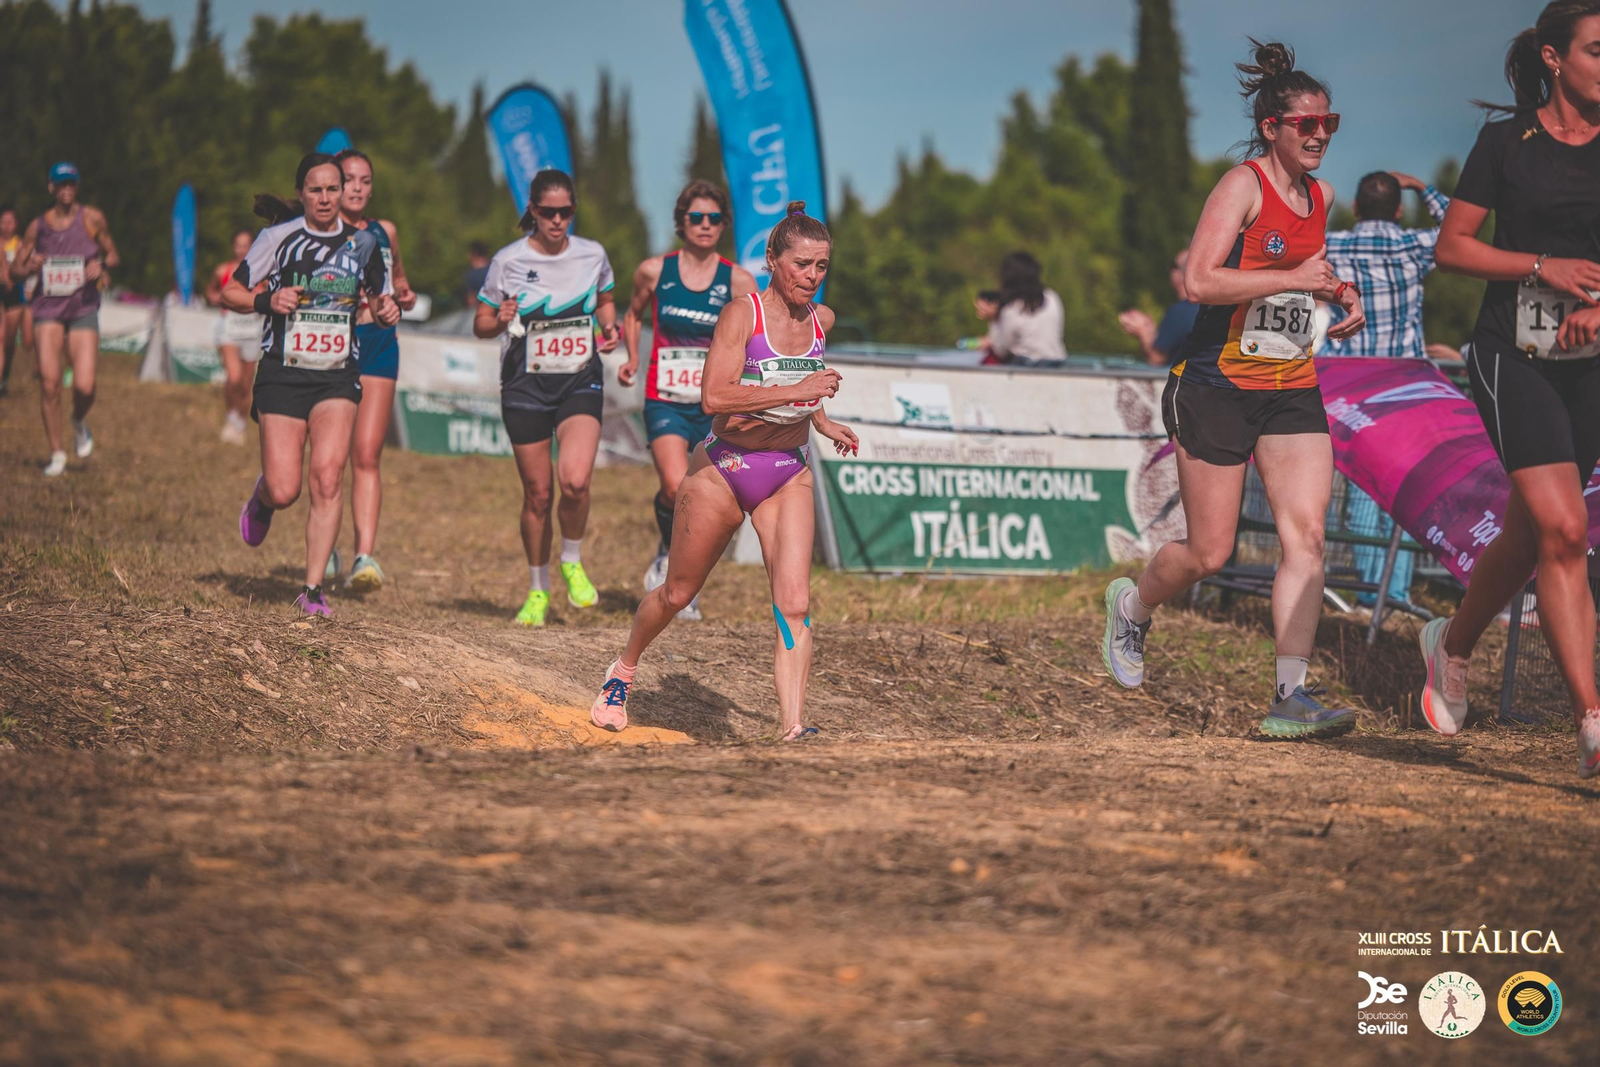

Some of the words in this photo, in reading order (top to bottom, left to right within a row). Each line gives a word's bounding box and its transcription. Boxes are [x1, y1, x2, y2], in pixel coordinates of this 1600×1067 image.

[1254, 304, 1312, 335] 1587
[292, 333, 345, 353] 1259
[535, 337, 587, 357] 1495
[871, 440, 954, 461] International
[999, 444, 1054, 468] Country
[837, 464, 916, 497] CROSS
[919, 467, 1101, 501] INTERNACIONAL
[910, 500, 1052, 560] ITÁLICA
